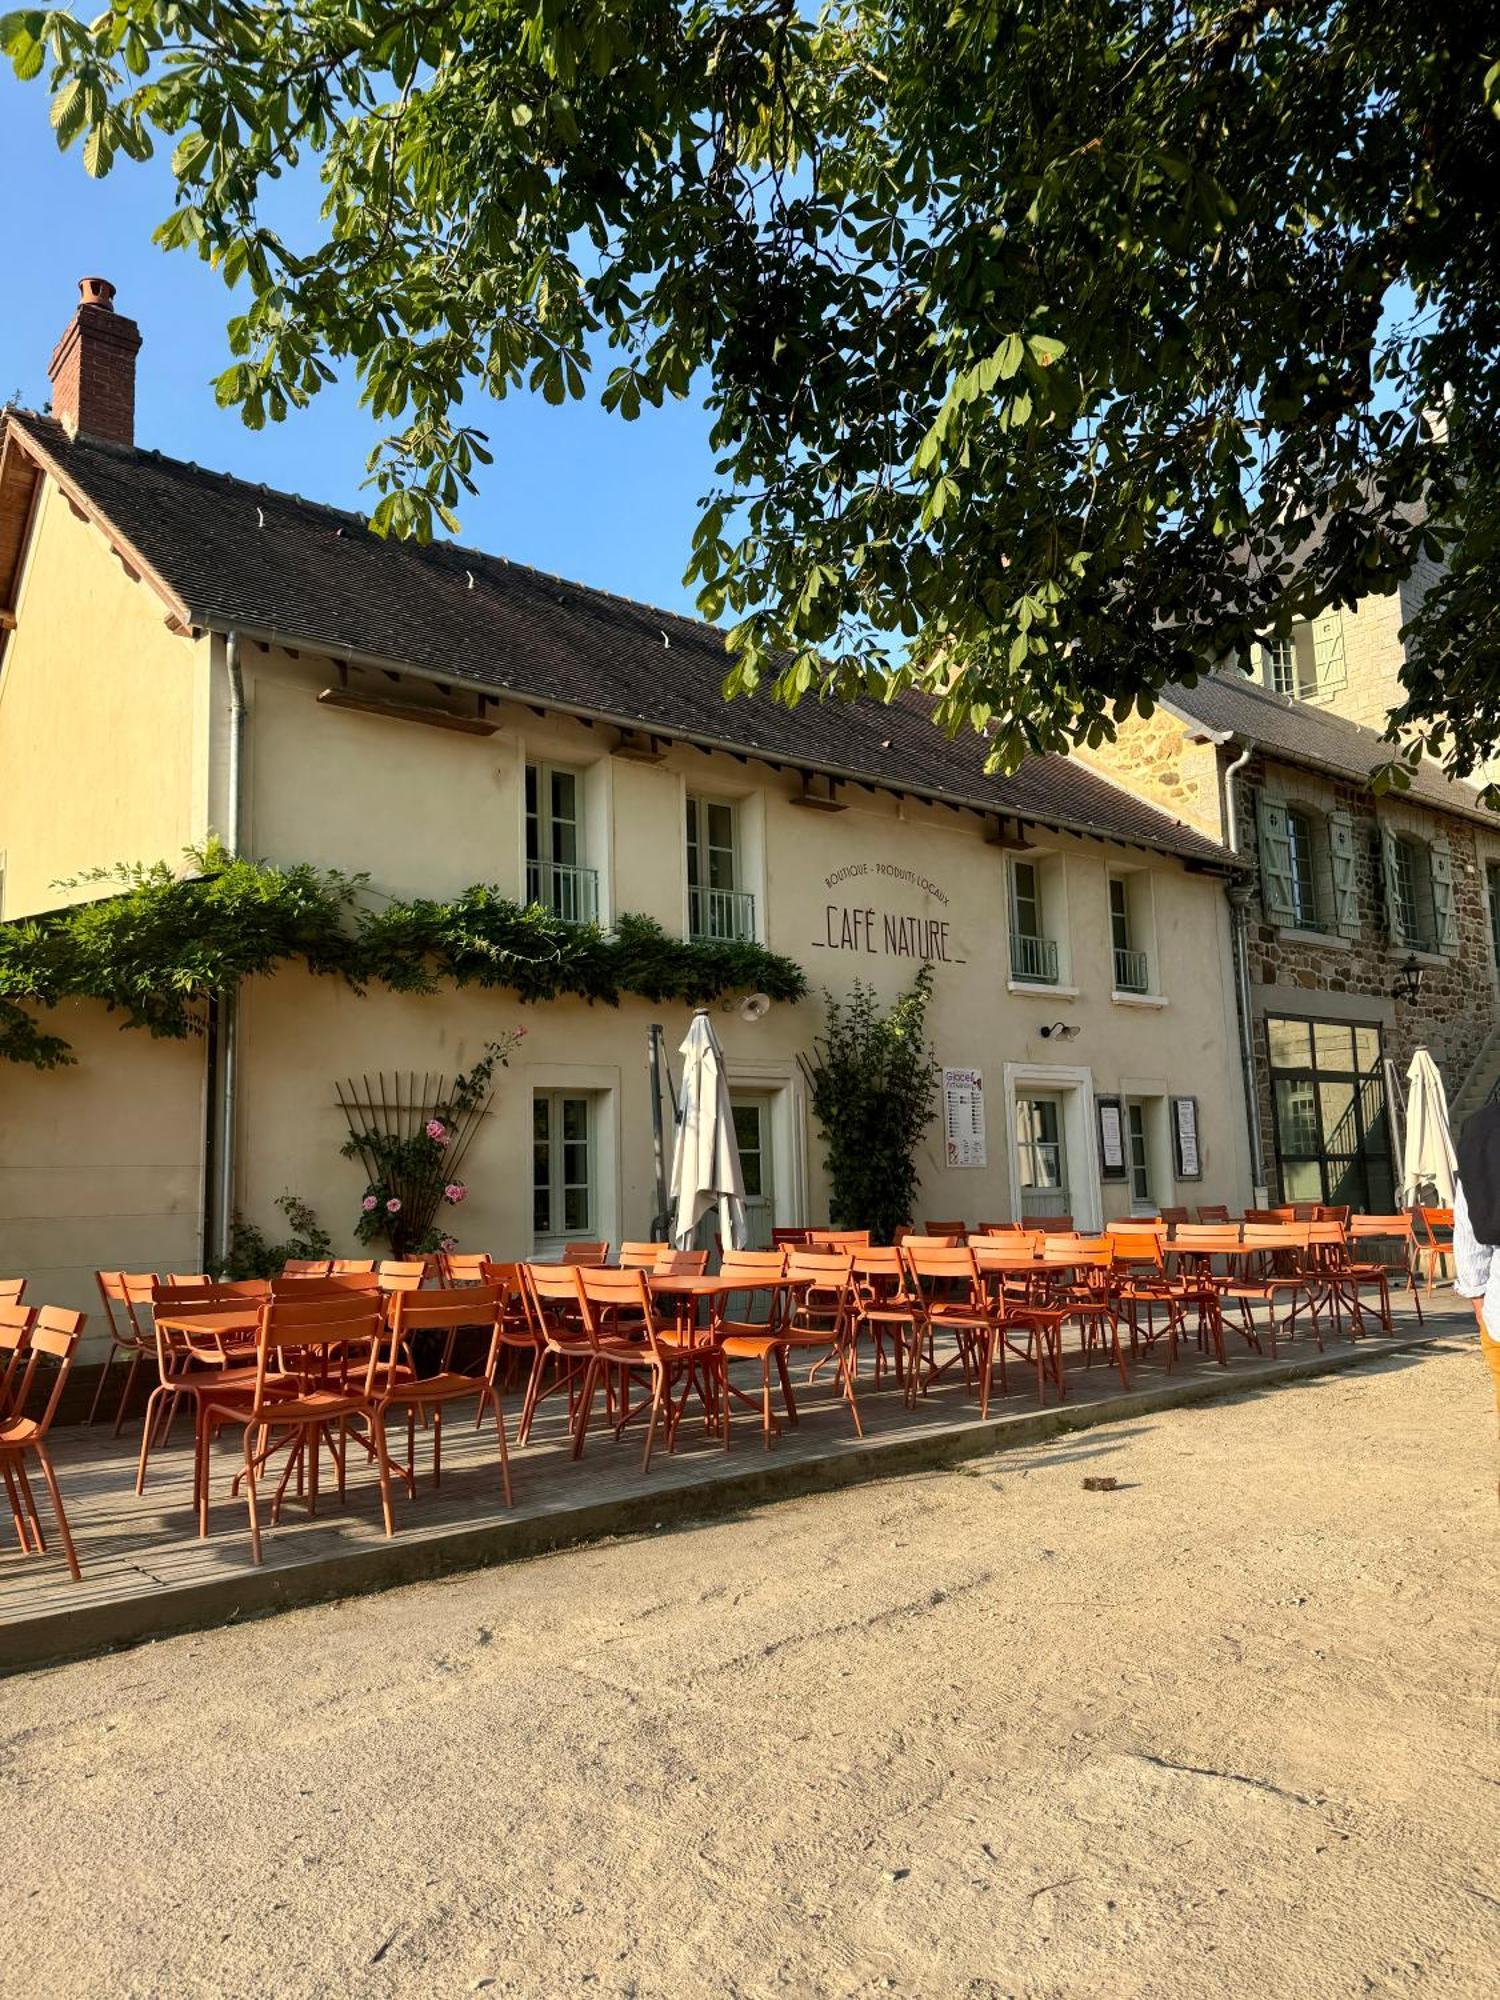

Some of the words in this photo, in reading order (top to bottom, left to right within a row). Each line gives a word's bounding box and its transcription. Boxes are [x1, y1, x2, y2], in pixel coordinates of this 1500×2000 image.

[824, 863, 868, 889] BOUTIQUE
[875, 863, 916, 885] PRODUITS
[917, 875, 950, 907] LOCAUX
[826, 905, 878, 954] CAFÉ
[883, 913, 952, 963] NATURE
